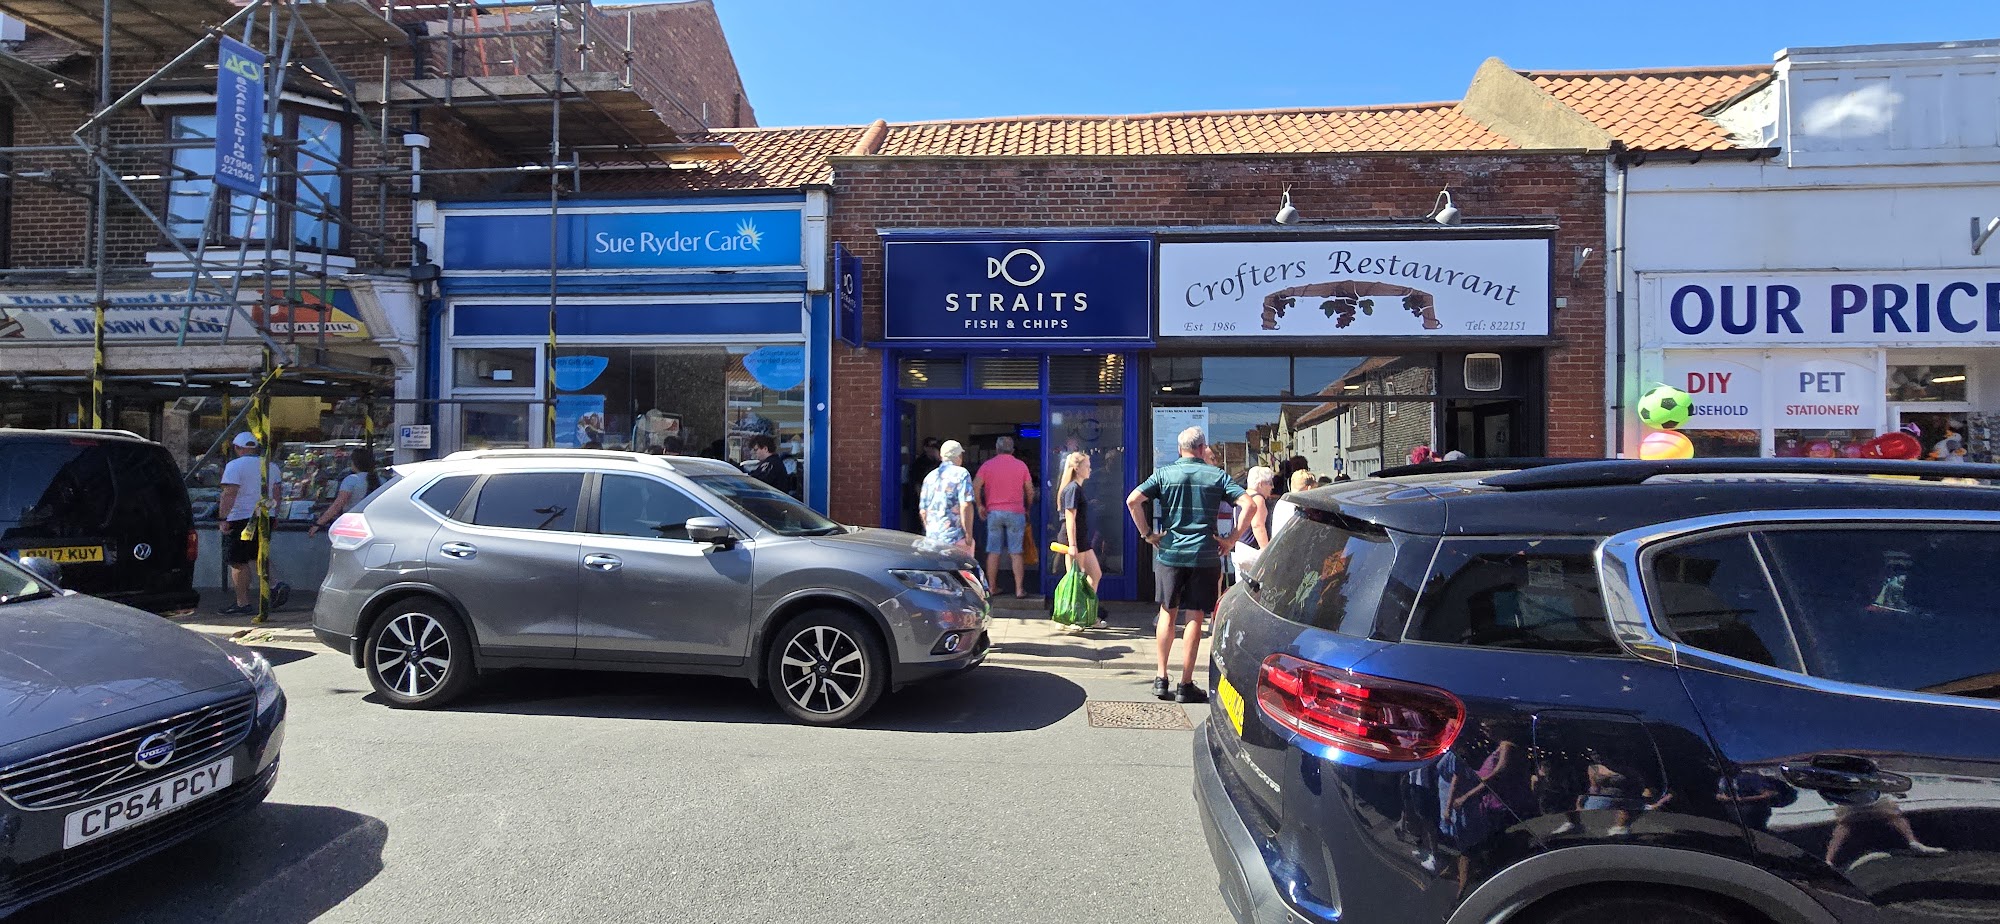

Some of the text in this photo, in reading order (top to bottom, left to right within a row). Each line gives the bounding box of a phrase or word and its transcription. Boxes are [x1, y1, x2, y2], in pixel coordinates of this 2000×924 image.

[233, 76, 246, 159] SCAFFOLDING
[595, 230, 753, 256] Sue Ryder Care
[1185, 250, 1520, 308] Crofters Restaurant
[945, 293, 1088, 312] STRAITS
[1670, 284, 1804, 335] OUR
[49, 317, 71, 334] &
[965, 319, 1069, 329] FISH & CHIPS
[1183, 321, 1237, 332] Est 1986
[1464, 319, 1527, 332] Tel: 822151
[1687, 372, 1732, 394] DIY
[1799, 372, 1846, 393] PET
[1692, 405, 1749, 416] USEHOLD
[1786, 405, 1860, 416] STATIONERY
[68, 548, 97, 560] KUY
[140, 743, 174, 758] VOLVO
[81, 763, 222, 836] CP64 PCY
